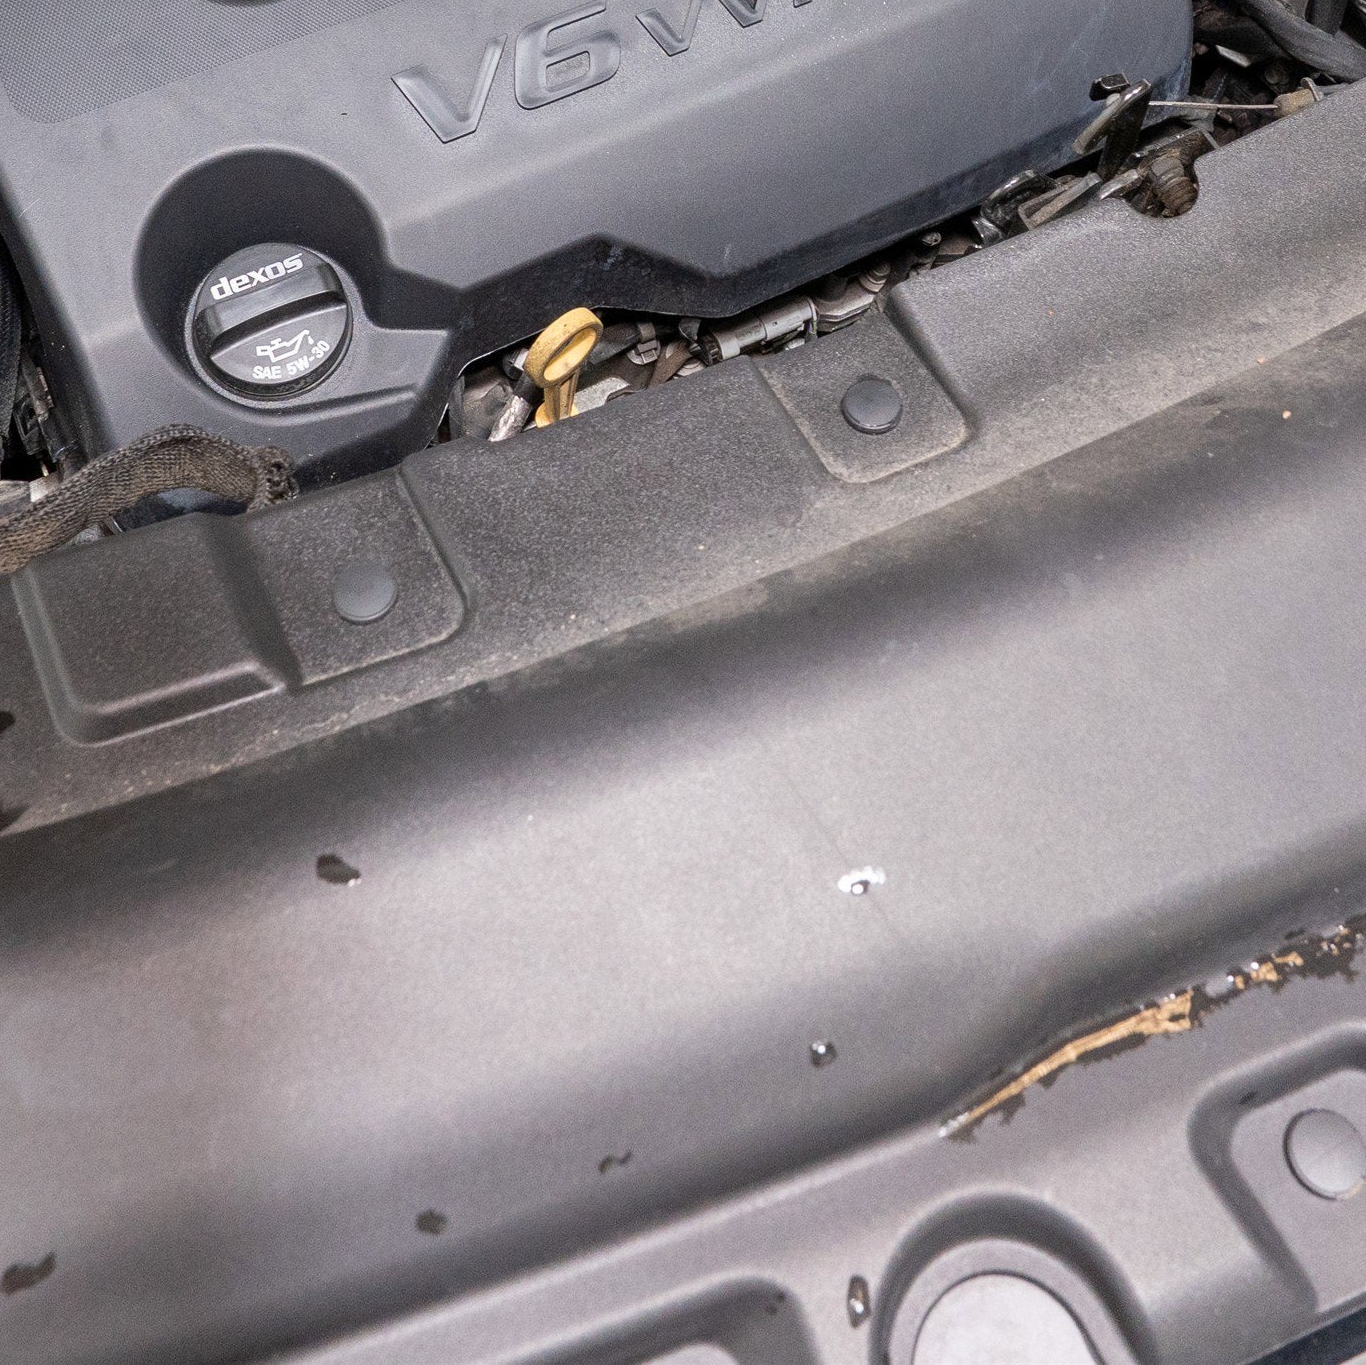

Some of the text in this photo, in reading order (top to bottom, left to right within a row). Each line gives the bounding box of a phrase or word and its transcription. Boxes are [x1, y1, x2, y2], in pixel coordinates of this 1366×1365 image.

[209, 252, 304, 301] dexos
[252, 340, 331, 380] SAE 5W-30
